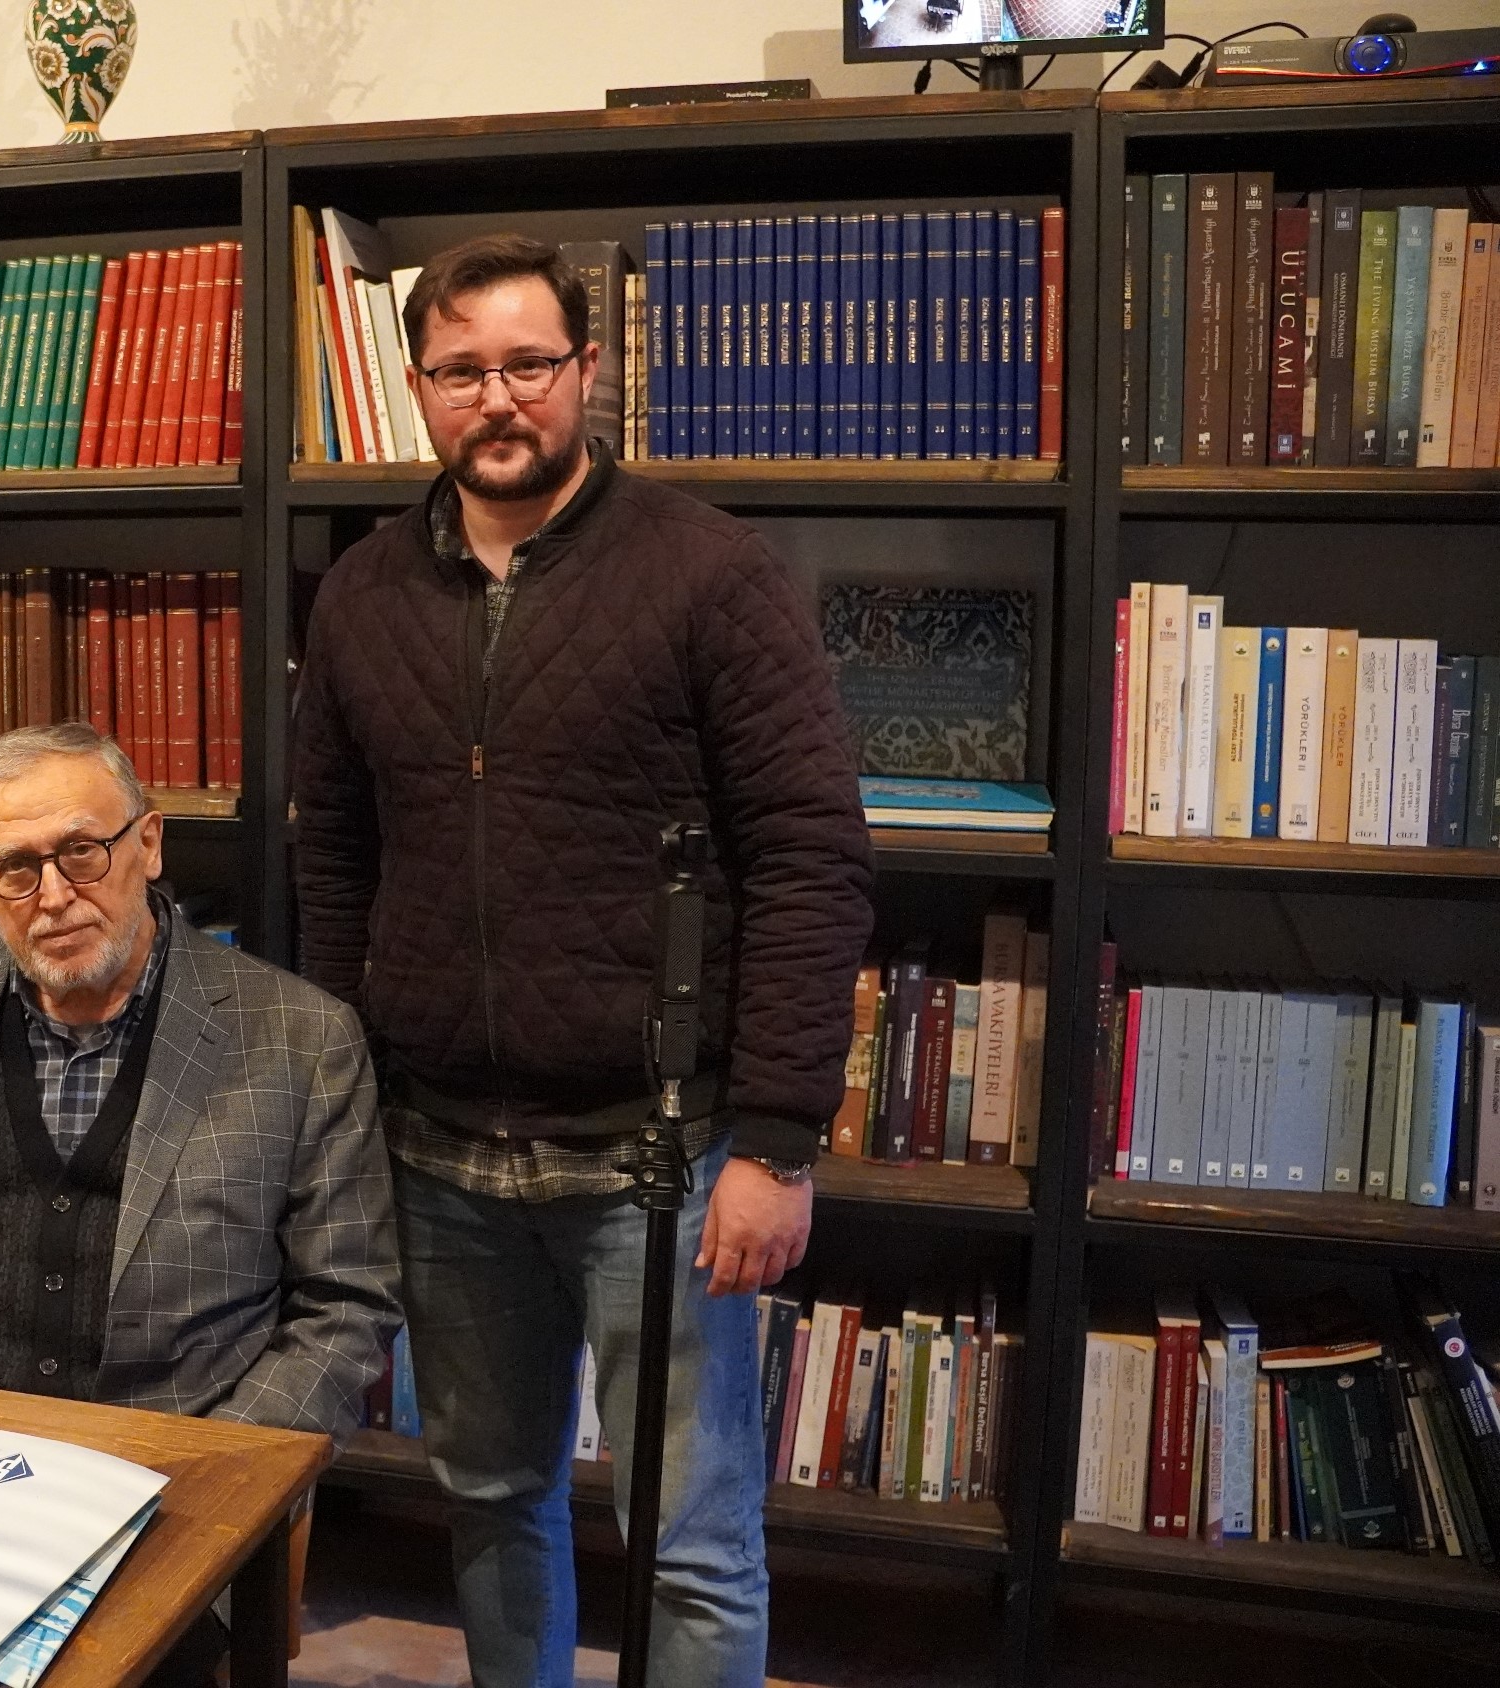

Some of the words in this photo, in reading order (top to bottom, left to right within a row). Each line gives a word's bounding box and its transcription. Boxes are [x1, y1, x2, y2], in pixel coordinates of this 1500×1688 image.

[981, 42, 1018, 56] exper
[1373, 259, 1384, 281] THE
[1338, 272, 1348, 308] OSMANLI
[1403, 276, 1417, 326] YAŞAYAN
[1440, 290, 1451, 324] Binbir
[1277, 250, 1300, 390] ULUCAMİ
[1336, 310, 1347, 358] DÖNEMİNDE
[365, 324, 378, 375] YAZILARI
[1368, 329, 1380, 376] MUSEUM
[1402, 329, 1415, 360] MÜZE
[1436, 326, 1449, 350] Gece
[373, 378, 382, 399] ÇİNİ
[1366, 381, 1378, 415] BURSA
[1400, 365, 1412, 400] BURSA
[1162, 665, 1173, 696] Binbir
[1200, 665, 1212, 726] BALKANLAR
[1160, 699, 1171, 723] Gece
[1451, 709, 1470, 729] Bursa
[1200, 729, 1209, 741] VE
[1298, 697, 1310, 761] YÖRÜKLER
[1336, 706, 1346, 767] YÖRÜKLER
[1449, 732, 1469, 758] Gezileri
[992, 943, 1010, 994] BURSA
[937, 1019, 945, 1032] BU
[932, 1036, 944, 1085] TOPRAĞIN
[985, 999, 1005, 1096] VAKFİYELERİ
[929, 1089, 940, 1134] RENKLERİ
[980, 1351, 990, 1378] Bursa
[977, 1380, 989, 1405] Keşif
[974, 1406, 987, 1452] Defterleri
[1161, 1463, 1165, 1471] 1
[1180, 1462, 1185, 1470] 2
